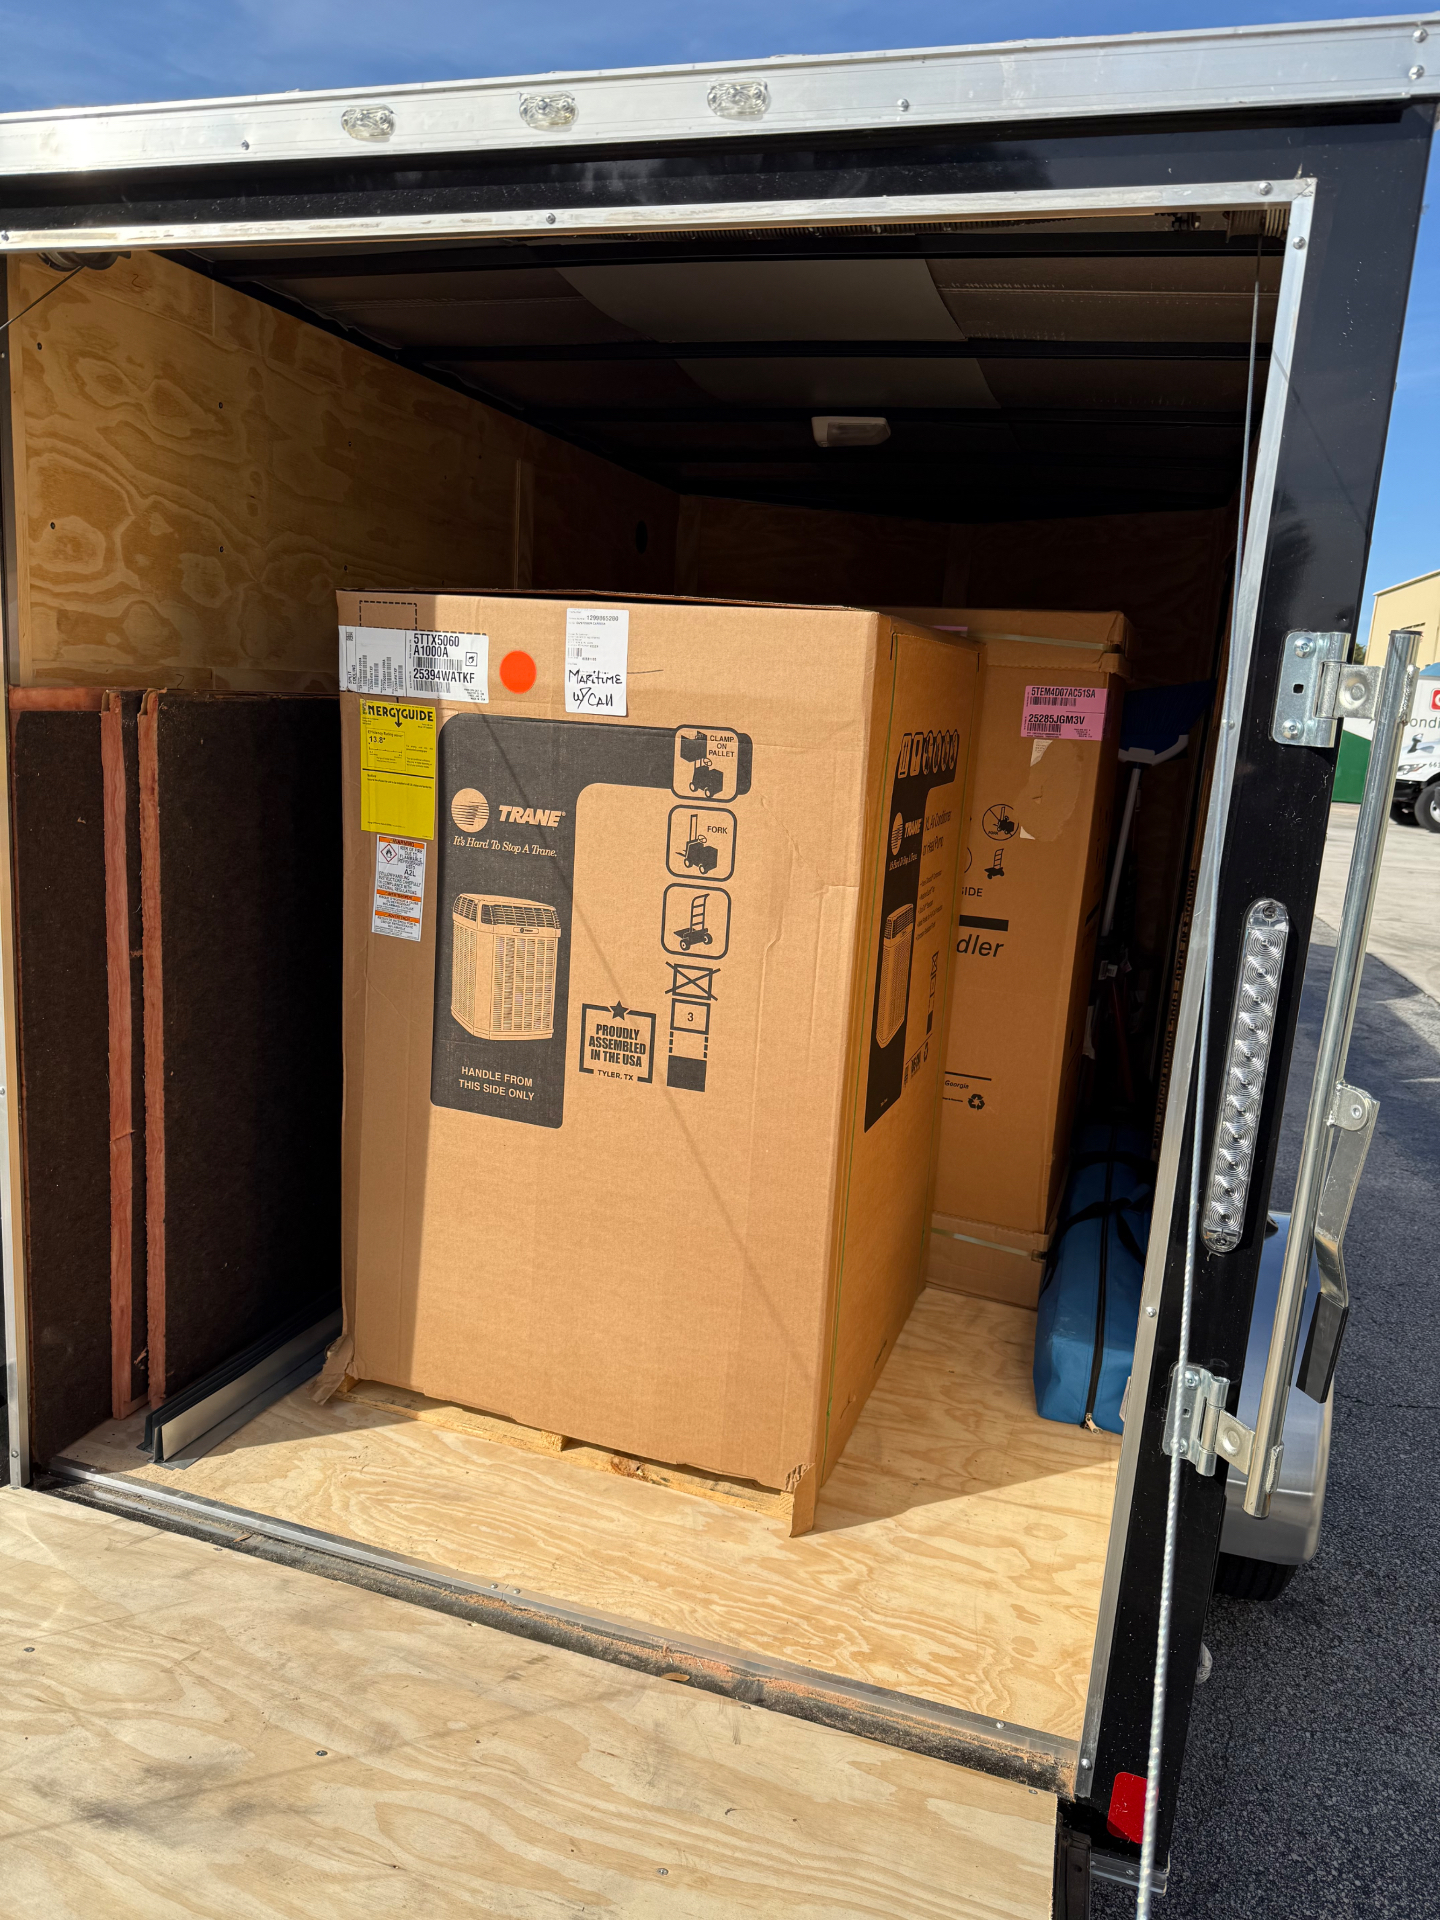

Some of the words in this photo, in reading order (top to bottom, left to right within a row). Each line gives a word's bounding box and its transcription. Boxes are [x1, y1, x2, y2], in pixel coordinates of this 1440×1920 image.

[413, 633, 459, 647] 5TTX5060
[413, 645, 449, 658] A1000A
[413, 668, 475, 683] 25394WATKF
[1031, 687, 1096, 698] 5TEM4D07AC51SA
[1028, 714, 1085, 725] 25285JGM3V
[709, 735, 735, 743] CLAMP
[708, 750, 735, 758] PALLET
[499, 805, 562, 828] TRANE
[707, 825, 728, 834] FORK
[453, 835, 465, 846] It's
[466, 837, 490, 849] Hard
[491, 840, 501, 850] To
[502, 842, 522, 854] Stop
[522, 844, 530, 854] A
[531, 844, 557, 857] Trane.
[404, 869, 416, 877] A2L
[956, 934, 1004, 957] dler
[687, 1012, 694, 1022] 3
[596, 1023, 640, 1041] PROUDLY
[588, 1036, 646, 1055] ASSEMBLED
[590, 1048, 601, 1061] IN
[602, 1050, 621, 1064] THE
[622, 1054, 642, 1068] USA
[461, 1066, 501, 1082] HANDLE
[504, 1074, 533, 1087] FROM
[623, 1073, 634, 1081] TX
[458, 1079, 480, 1091] THIS
[482, 1083, 506, 1096] SIDE
[508, 1087, 535, 1101] ONLY
